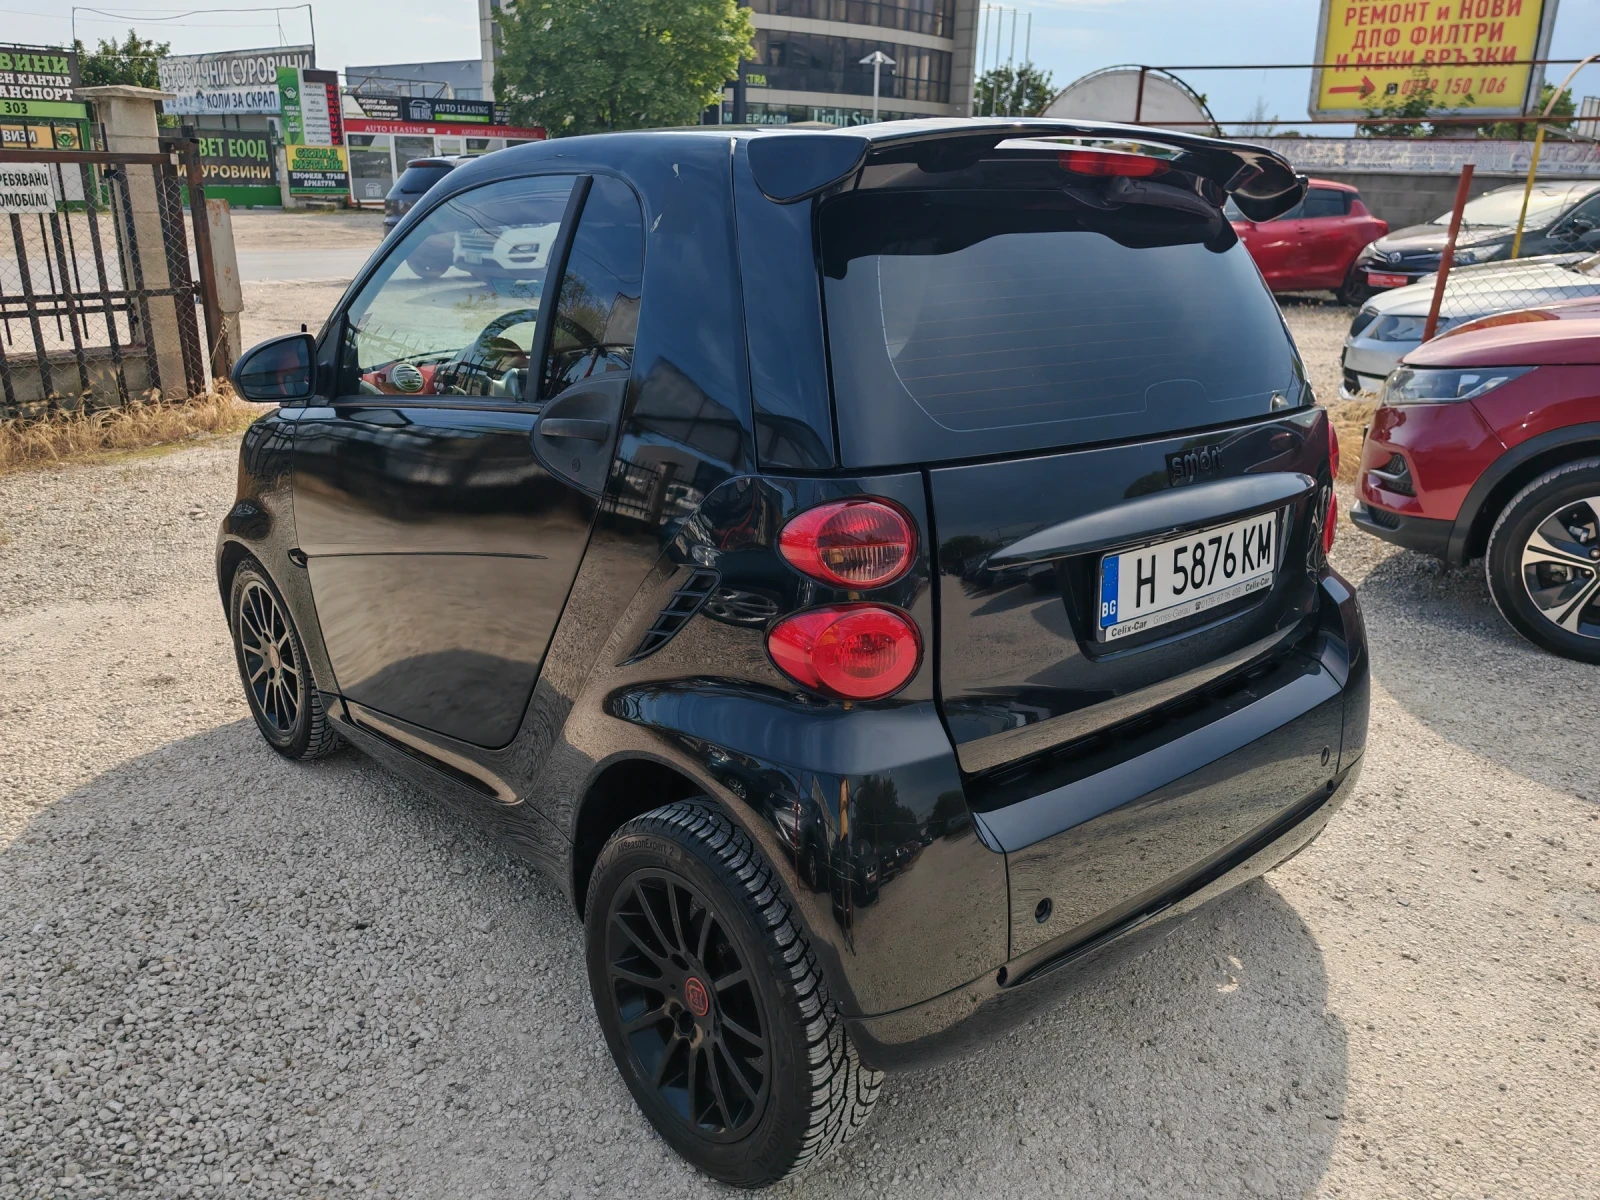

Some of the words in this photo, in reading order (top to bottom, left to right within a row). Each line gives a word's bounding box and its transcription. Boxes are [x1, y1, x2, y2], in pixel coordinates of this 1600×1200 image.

[1344, 2, 1430, 26] РЕМОНТ
[1459, 0, 1522, 19] НОВИ
[1352, 27, 1401, 51] ДПФ
[1409, 22, 1505, 46] ФИЛТРИ
[0, 52, 70, 74] ВИНИ
[1334, 53, 1348, 72] И
[1355, 50, 1415, 71] МЕКИ
[1424, 46, 1517, 68] ВРЪЗКИ
[17, 74, 72, 87] КАНТАР
[161, 60, 229, 88] ВТОРИЧНИ
[1444, 78, 1473, 94] 150
[1478, 77, 1507, 94] 106
[5, 102, 28, 114] 303
[206, 92, 231, 108] КОЛИ
[232, 92, 245, 108] ЗА
[245, 91, 277, 108] СКРАП
[435, 104, 456, 112] AUTO
[457, 105, 489, 114] LEASING
[813, 109, 849, 126] Light
[852, 112, 884, 126] Stye
[389, 126, 424, 134] LEASING
[198, 137, 224, 157] ВЕТ
[228, 138, 268, 162] ЕООД
[295, 148, 338, 160] СКЛАД
[201, 164, 271, 179] УРОВИНИ
[292, 159, 343, 170] МЕТАЛИ
[1135, 554, 1156, 608] H
[1172, 532, 1237, 596] 5876
[1242, 520, 1272, 574] KM
[1102, 599, 1117, 617] BG
[1111, 618, 1148, 637] Celix-Car
[1153, 606, 1191, 624] Gross-Gerau
[1245, 576, 1270, 592] Celix-Car
[669, 845, 674, 856] 2
